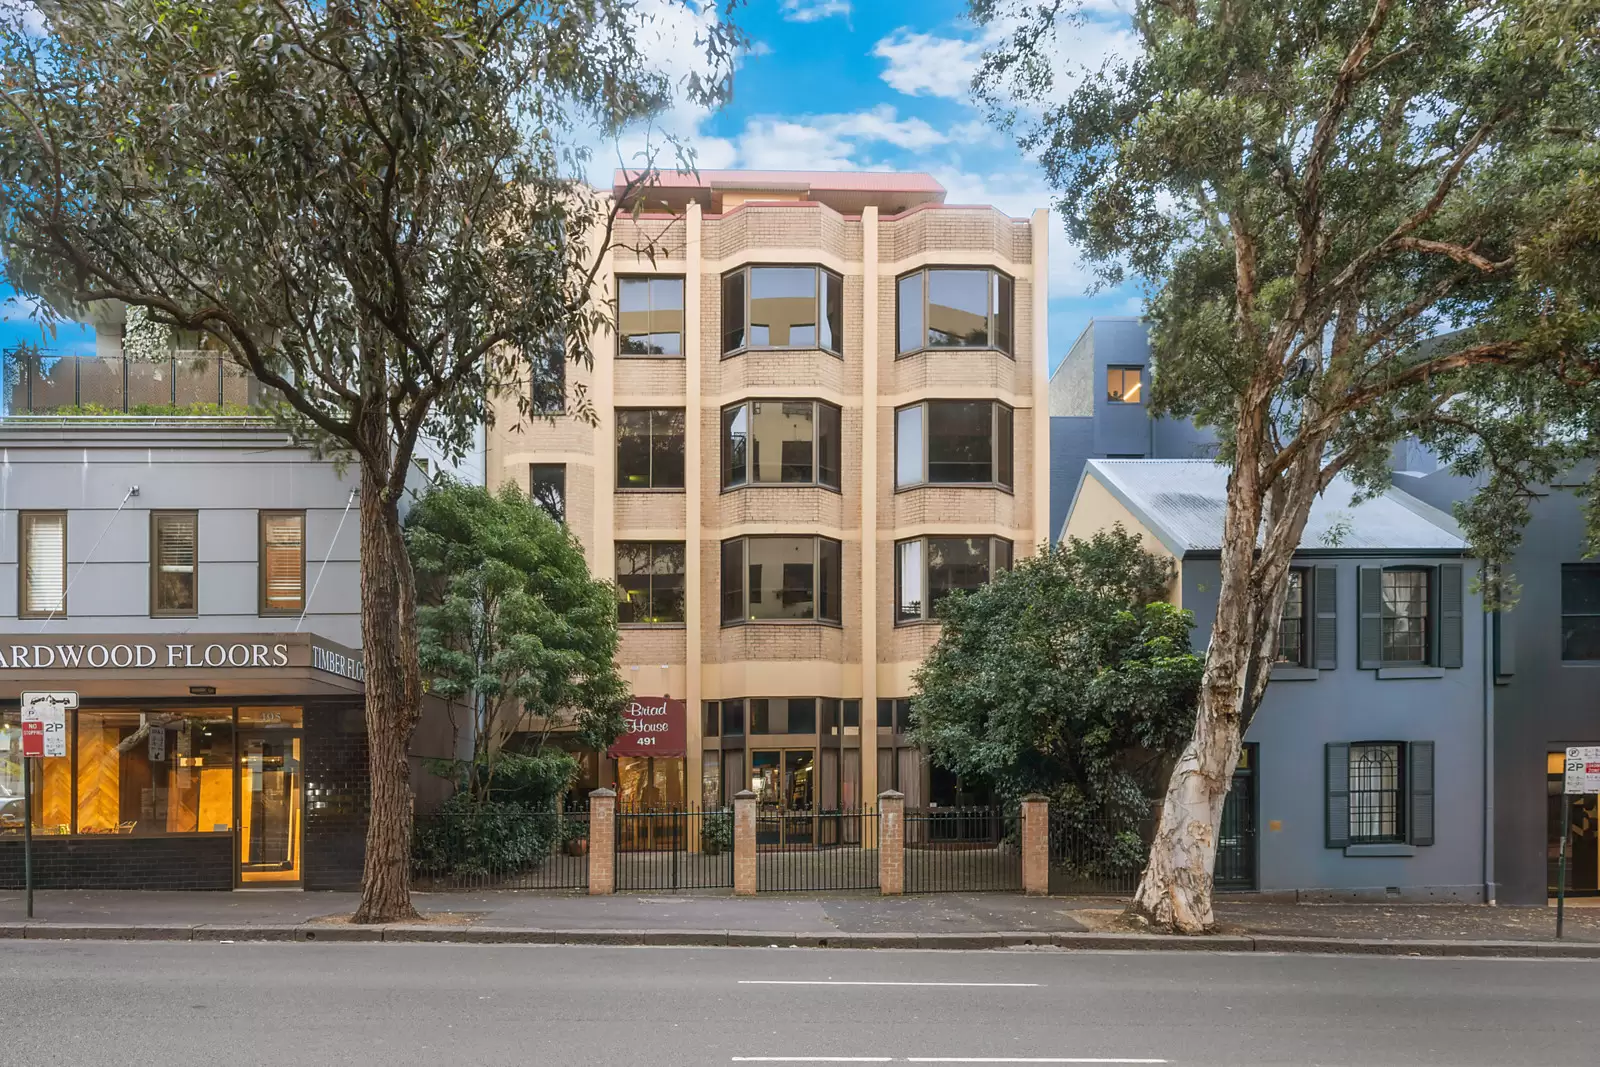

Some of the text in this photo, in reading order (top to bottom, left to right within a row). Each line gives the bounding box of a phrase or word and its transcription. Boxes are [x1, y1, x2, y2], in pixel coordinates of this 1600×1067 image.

[165, 644, 288, 667] FLOORS
[312, 645, 346, 677] TIMBER
[625, 702, 667, 716] Briad
[45, 723, 64, 733] 2P
[623, 718, 669, 733] House
[637, 737, 656, 745] 491
[1567, 763, 1584, 771] 2P
